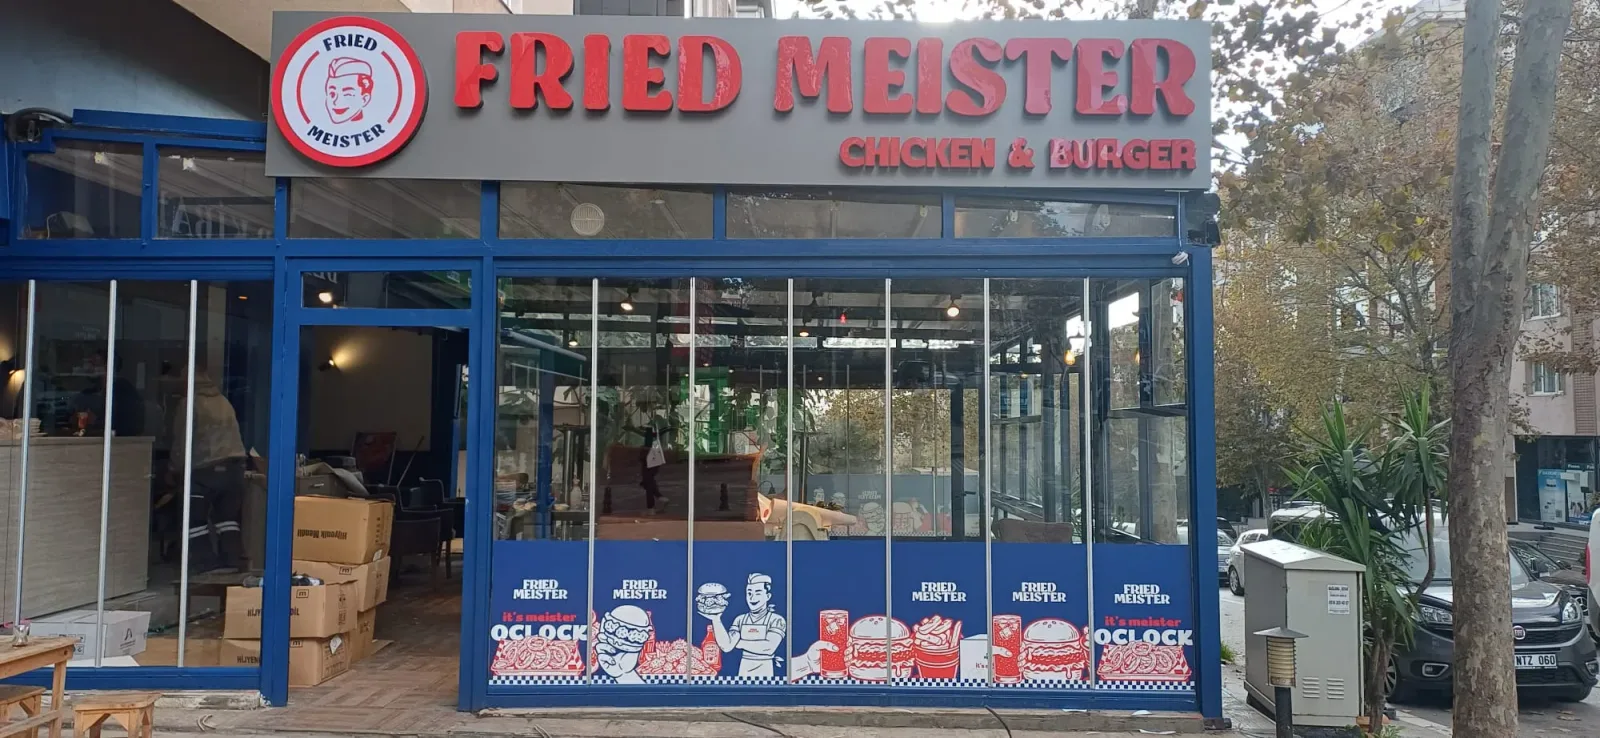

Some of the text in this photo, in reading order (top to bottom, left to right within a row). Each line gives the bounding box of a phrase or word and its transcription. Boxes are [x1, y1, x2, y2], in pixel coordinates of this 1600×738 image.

[322, 33, 378, 53] FRIED
[453, 31, 1197, 117] FRIED MEISTER
[307, 123, 386, 148] MEISTER
[839, 136, 1196, 170] CHICKEN & BURGER
[522, 579, 559, 590] FRIED
[622, 579, 658, 590] FRIED
[921, 581, 957, 592] FRIED
[1020, 581, 1057, 592] FRIED
[1123, 583, 1160, 595] FRIED
[512, 588, 568, 600] MEISTER
[612, 588, 667, 600] MEISTER
[911, 591, 967, 603] MEISTER
[1011, 591, 1067, 603] MEISTER
[1113, 593, 1171, 605] MEISTER
[502, 611, 577, 622] it's meister
[1104, 616, 1182, 628] it's meister
[490, 624, 588, 641] OCLOCK
[1094, 629, 1193, 646] OCLOCK
[1516, 655, 1556, 666] NTZ 060
